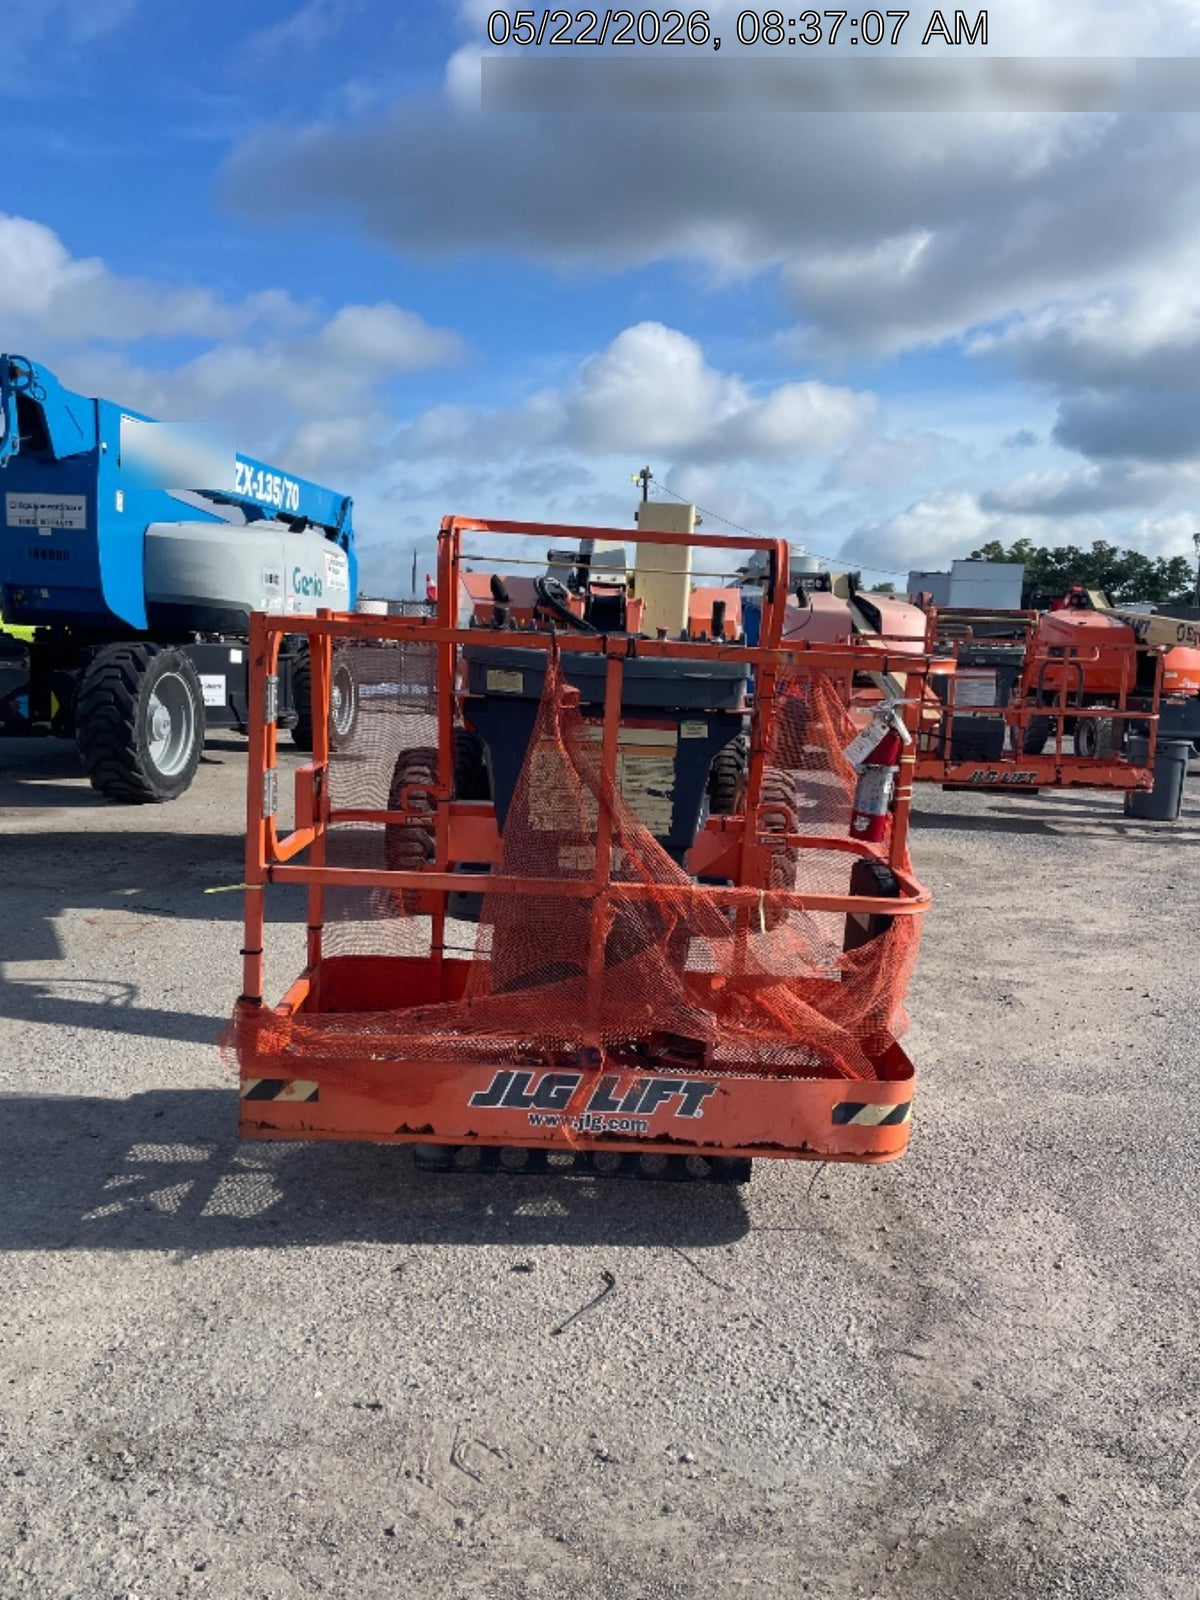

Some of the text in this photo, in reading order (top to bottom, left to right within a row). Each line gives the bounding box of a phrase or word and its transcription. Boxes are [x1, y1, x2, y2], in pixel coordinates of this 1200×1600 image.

[292, 566, 323, 598] Genie
[1001, 770, 1038, 785] LIFT
[467, 1070, 720, 1119] JLG LIFT
[528, 1112, 649, 1133] www.jlg.com
